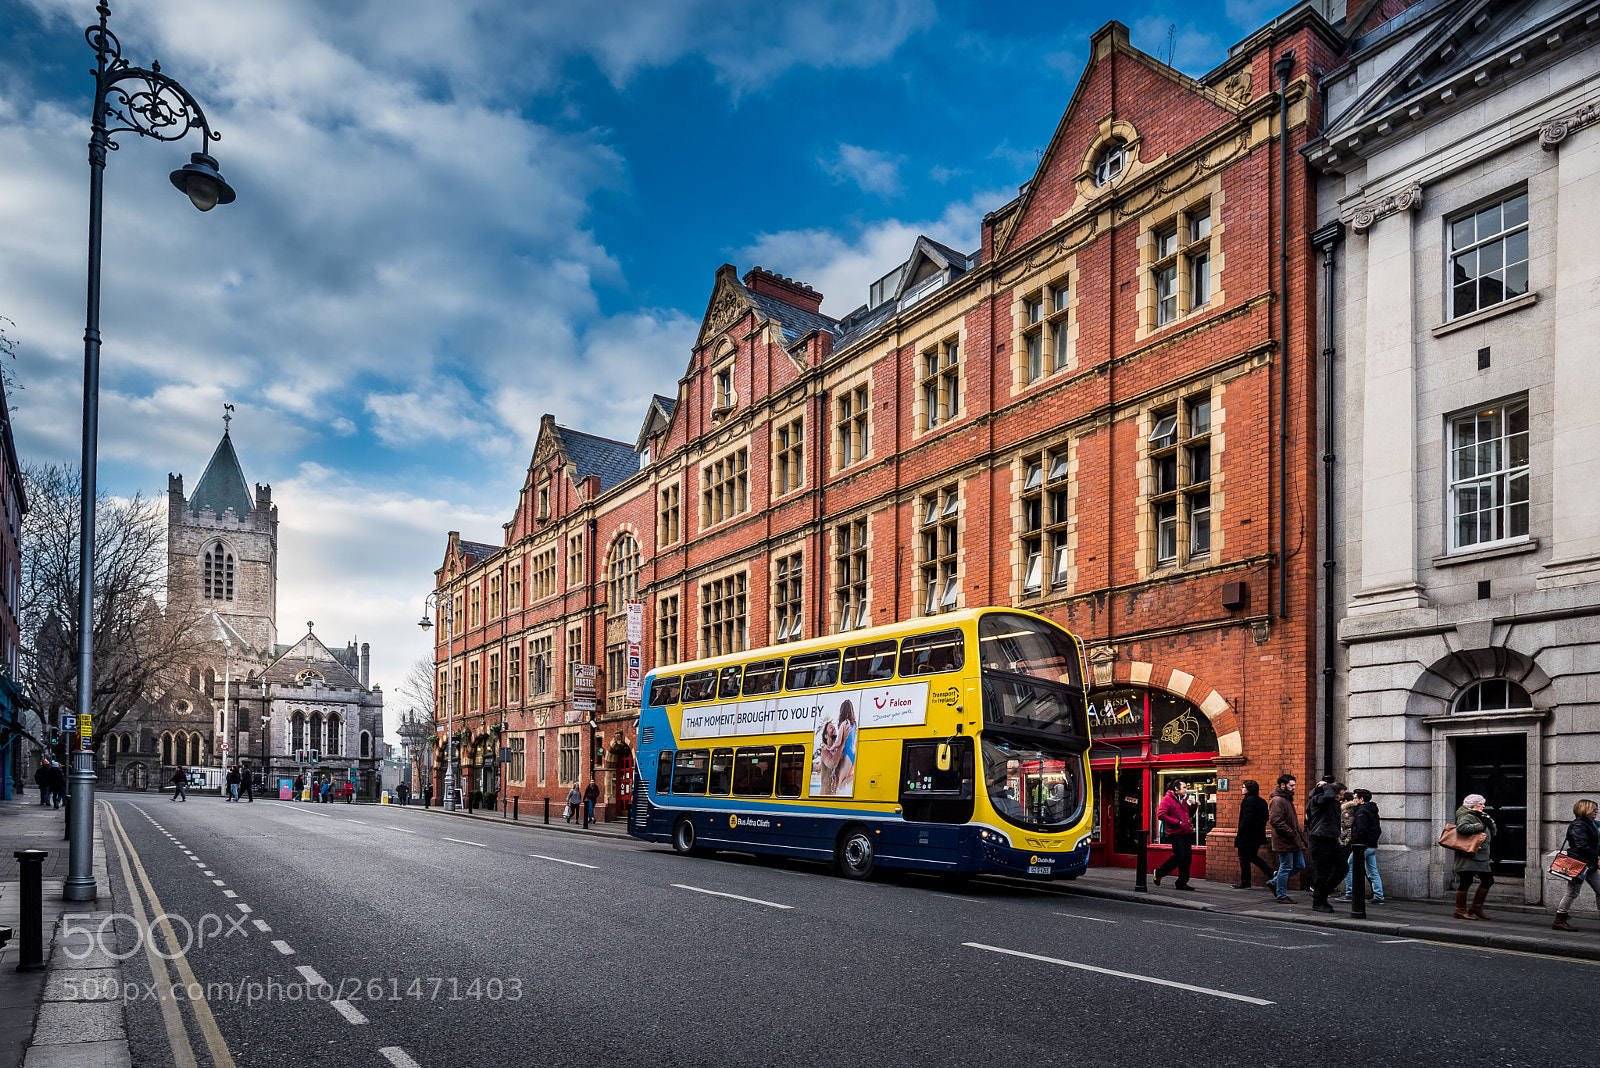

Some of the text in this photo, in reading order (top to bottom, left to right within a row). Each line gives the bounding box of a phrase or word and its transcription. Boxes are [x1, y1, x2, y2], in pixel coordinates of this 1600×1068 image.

[575, 678, 594, 687] HOSTEL
[932, 690, 956, 698] Transport
[889, 698, 912, 708] Falcon
[686, 705, 824, 728] THAT MOMENT, BROUGHT TO YOU BY
[737, 818, 746, 826] Bus
